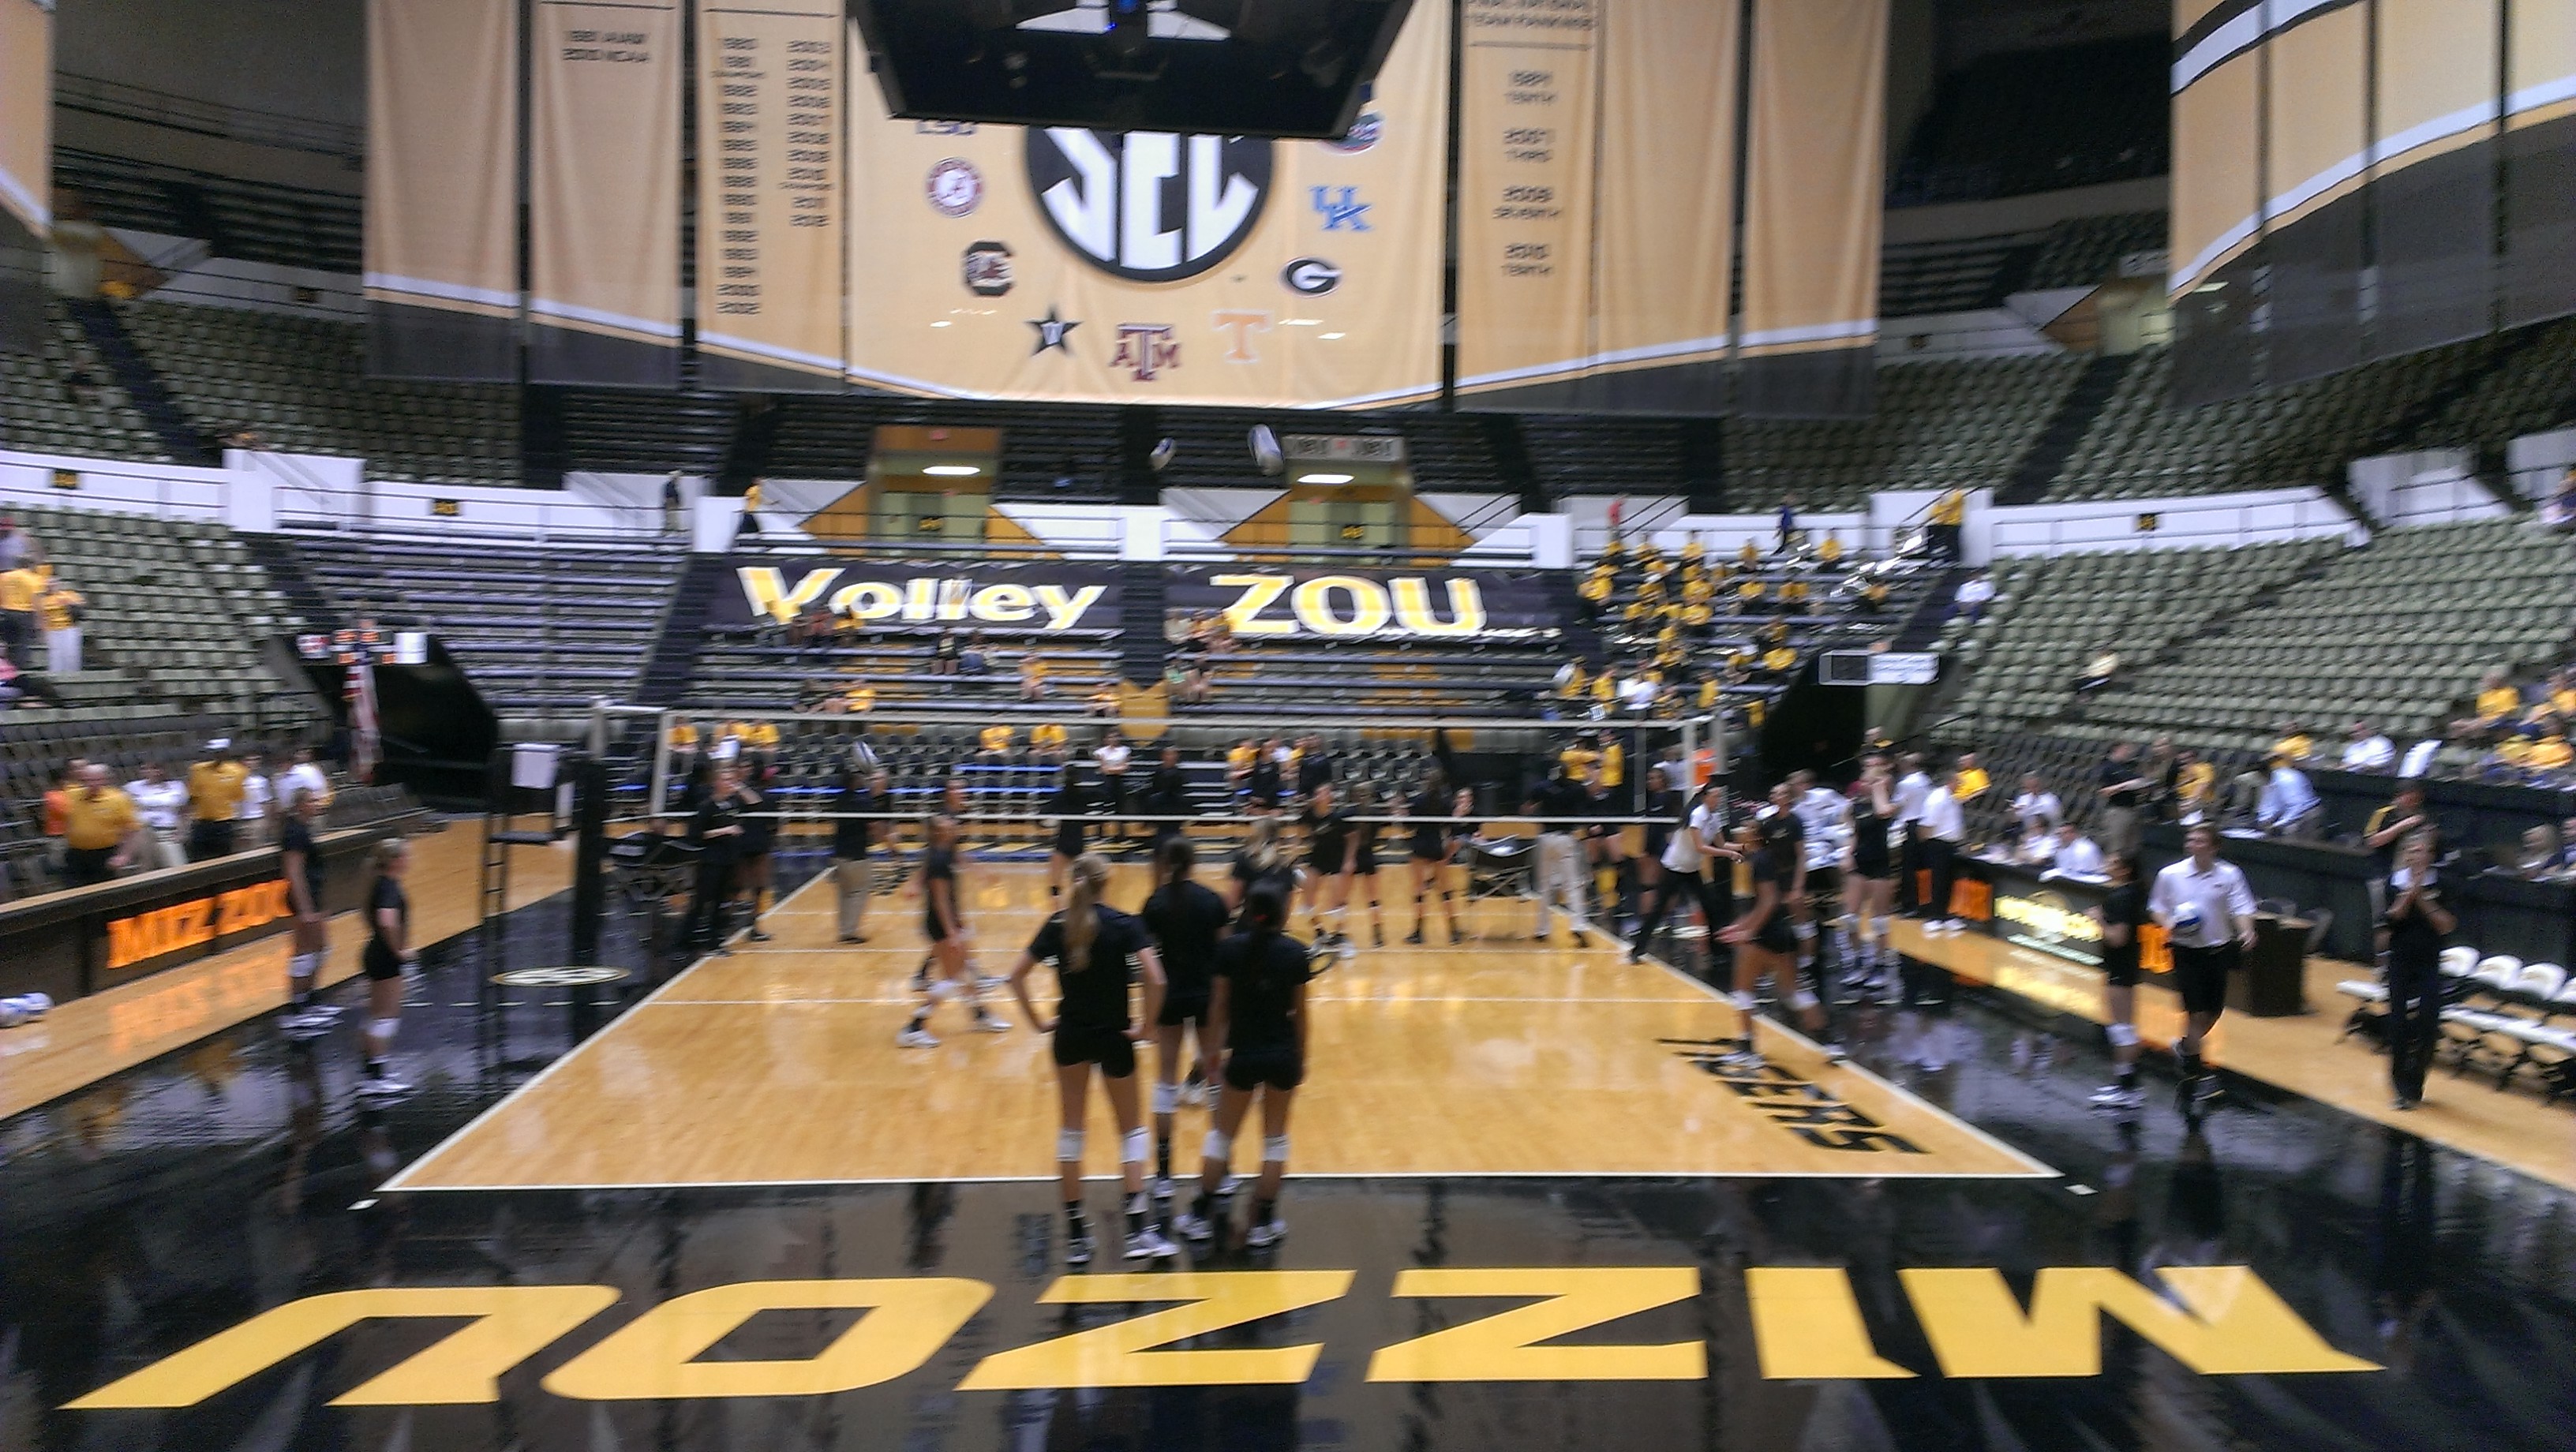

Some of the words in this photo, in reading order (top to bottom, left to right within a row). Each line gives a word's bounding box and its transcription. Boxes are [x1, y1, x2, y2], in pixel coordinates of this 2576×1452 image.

[736, 565, 1109, 631] Volley
[1209, 574, 1488, 634] ZOU
[52, 1264, 2390, 1409] MIZZOU
